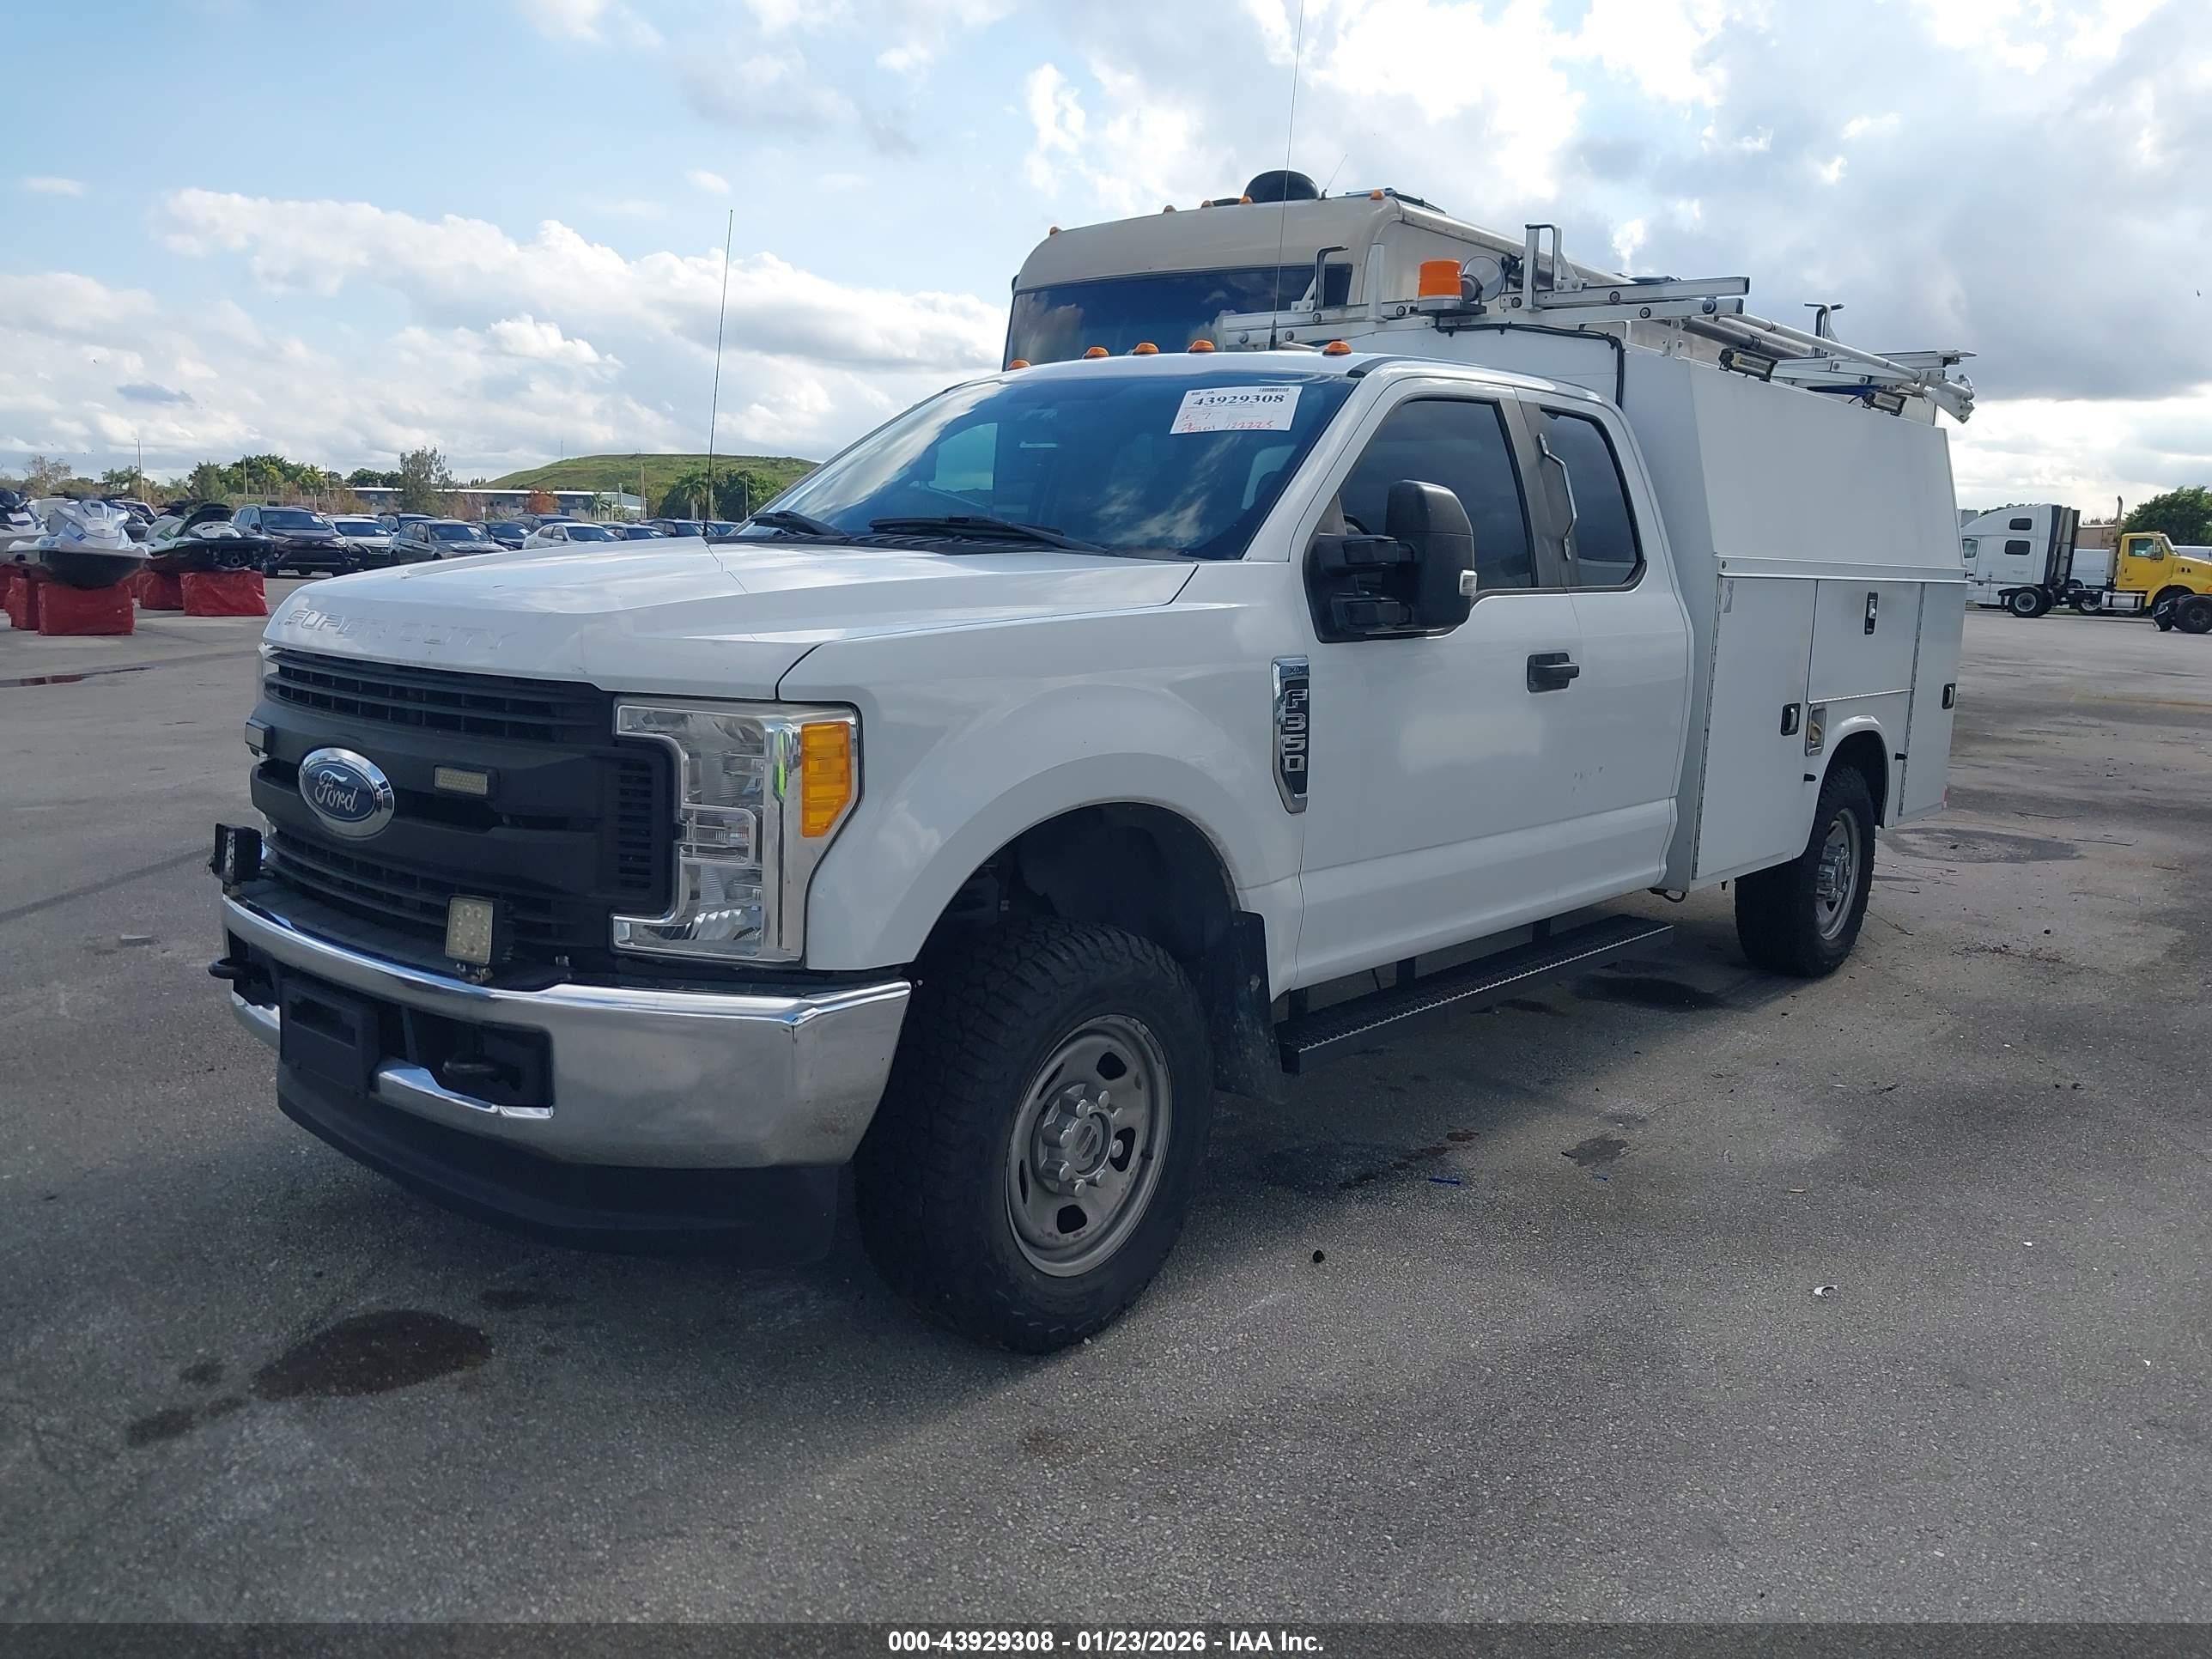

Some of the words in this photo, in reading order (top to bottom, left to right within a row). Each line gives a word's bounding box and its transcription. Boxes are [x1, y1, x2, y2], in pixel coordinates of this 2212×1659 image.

[1193, 395, 1285, 406] 43929308
[1284, 689, 1308, 772] F350
[314, 770, 359, 812] Ford
